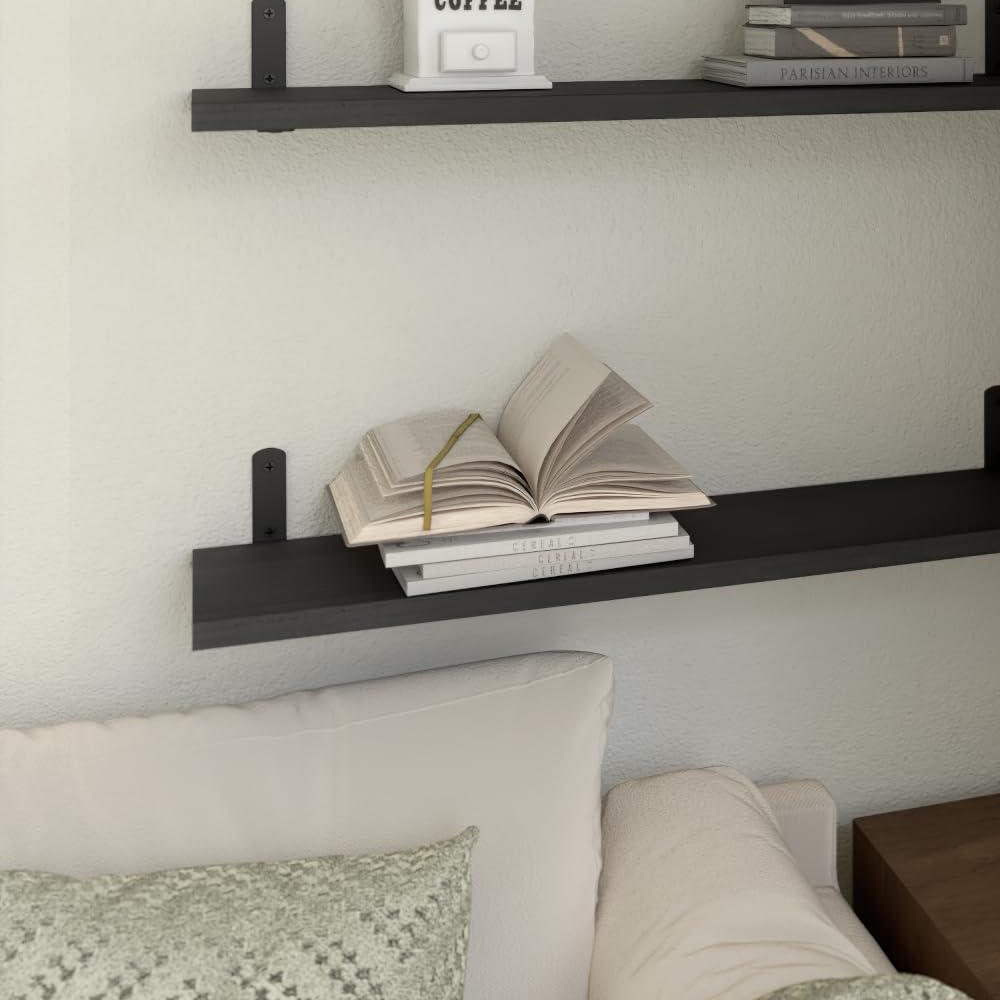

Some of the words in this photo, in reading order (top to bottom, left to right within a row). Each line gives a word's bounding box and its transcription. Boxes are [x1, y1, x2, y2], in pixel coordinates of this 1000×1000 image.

[780, 66, 848, 80] PARISIAN
[854, 65, 928, 79] INTERIORS
[512, 537, 562, 553] CEREAL
[537, 549, 583, 564] CEREAL
[532, 560, 580, 577] CEREAL
